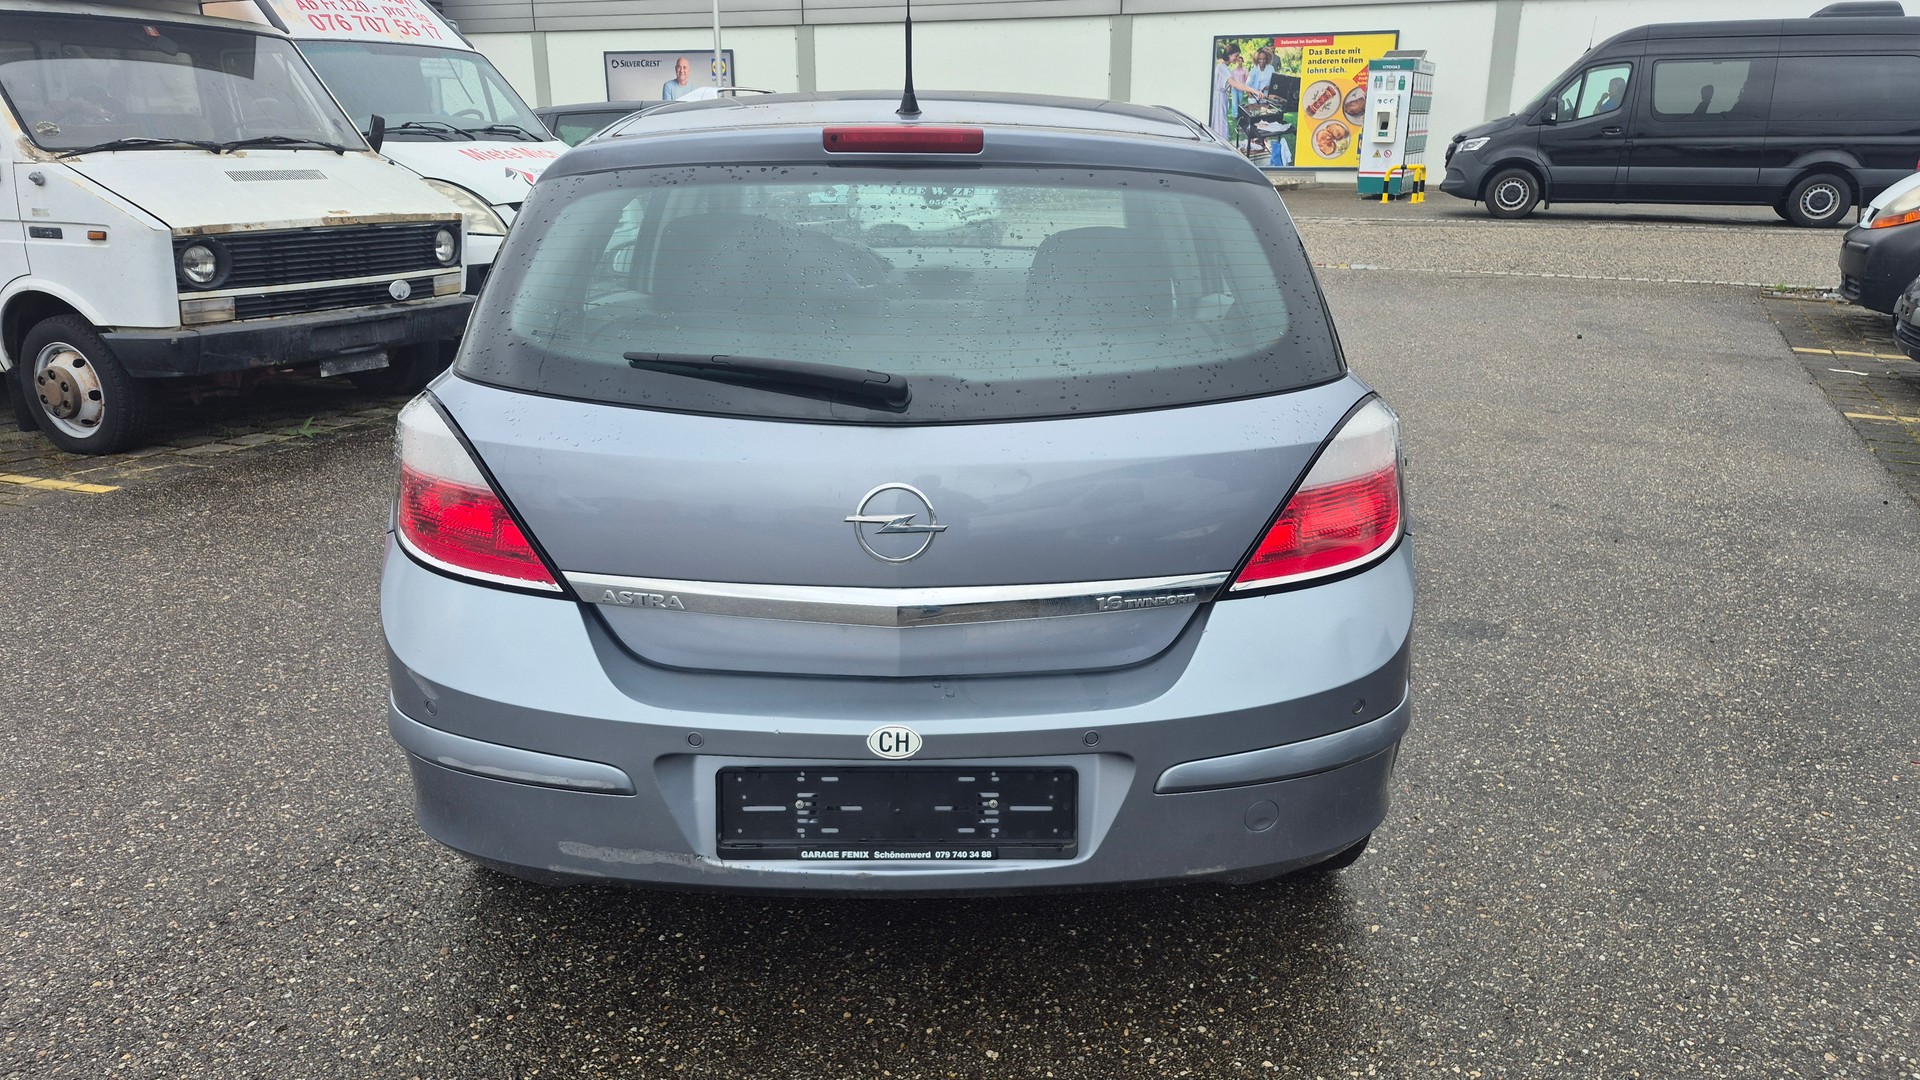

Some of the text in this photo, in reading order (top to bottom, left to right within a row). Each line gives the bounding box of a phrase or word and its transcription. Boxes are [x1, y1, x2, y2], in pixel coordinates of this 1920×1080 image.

[381, 5, 405, 18] pro
[403, 7, 433, 26] Tag
[307, 14, 443, 40] 076 707 55 17
[1308, 48, 1323, 56] Das
[1329, 66, 1347, 74] sich.
[458, 148, 522, 161] Miete
[601, 589, 686, 609] ASTRA
[1124, 593, 1195, 609] TWINPORT
[879, 731, 910, 752] CH
[801, 850, 992, 859] GARAGE FENIX Schönenwerd 079 740 34 88
